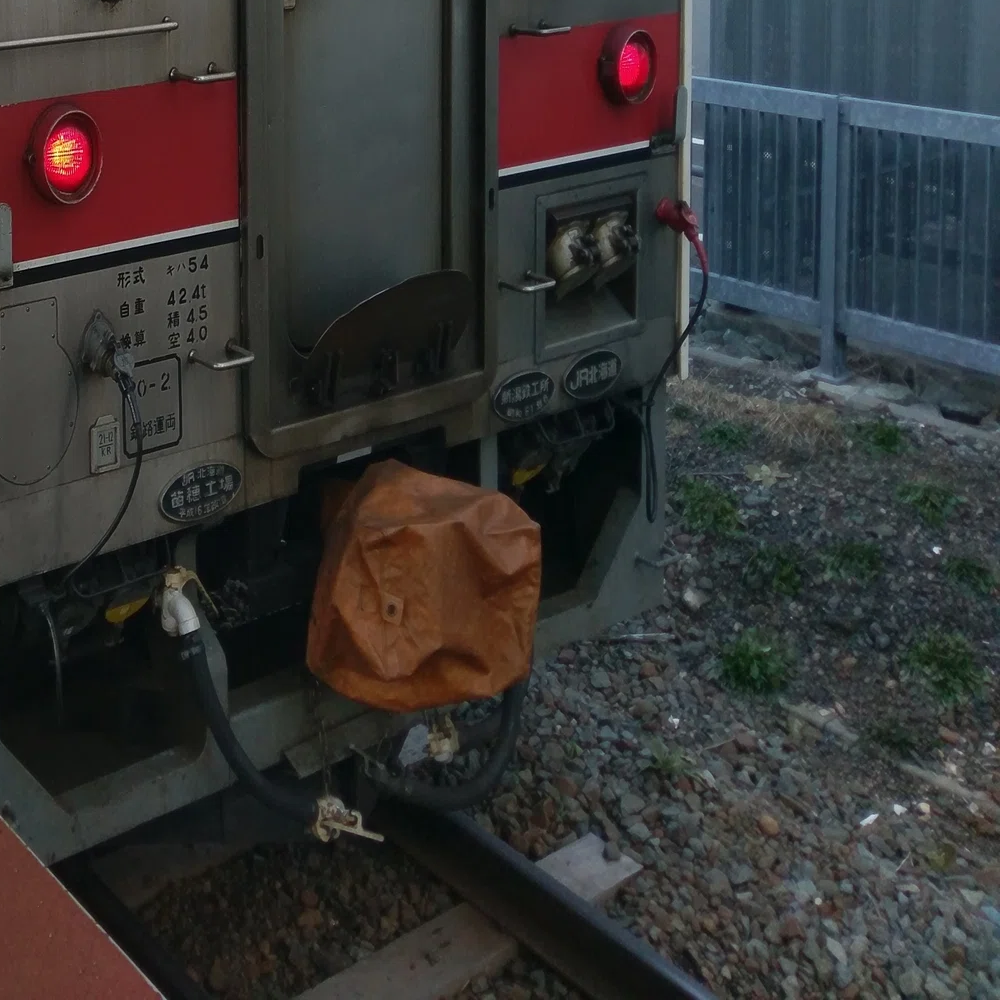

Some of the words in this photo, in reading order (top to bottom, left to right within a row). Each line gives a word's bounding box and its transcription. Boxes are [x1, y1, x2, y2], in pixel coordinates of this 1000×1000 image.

[117, 266, 146, 288] 形式
[119, 297, 146, 318] 自重
[167, 284, 206, 306] 42.4t
[186, 305, 208, 324] 4.5
[119, 328, 147, 350] 換算
[168, 332, 181, 349] 空
[186, 325, 208, 344] 4.0
[101, 446, 112, 457] KR
[170, 474, 234, 508] 苗穂工場
